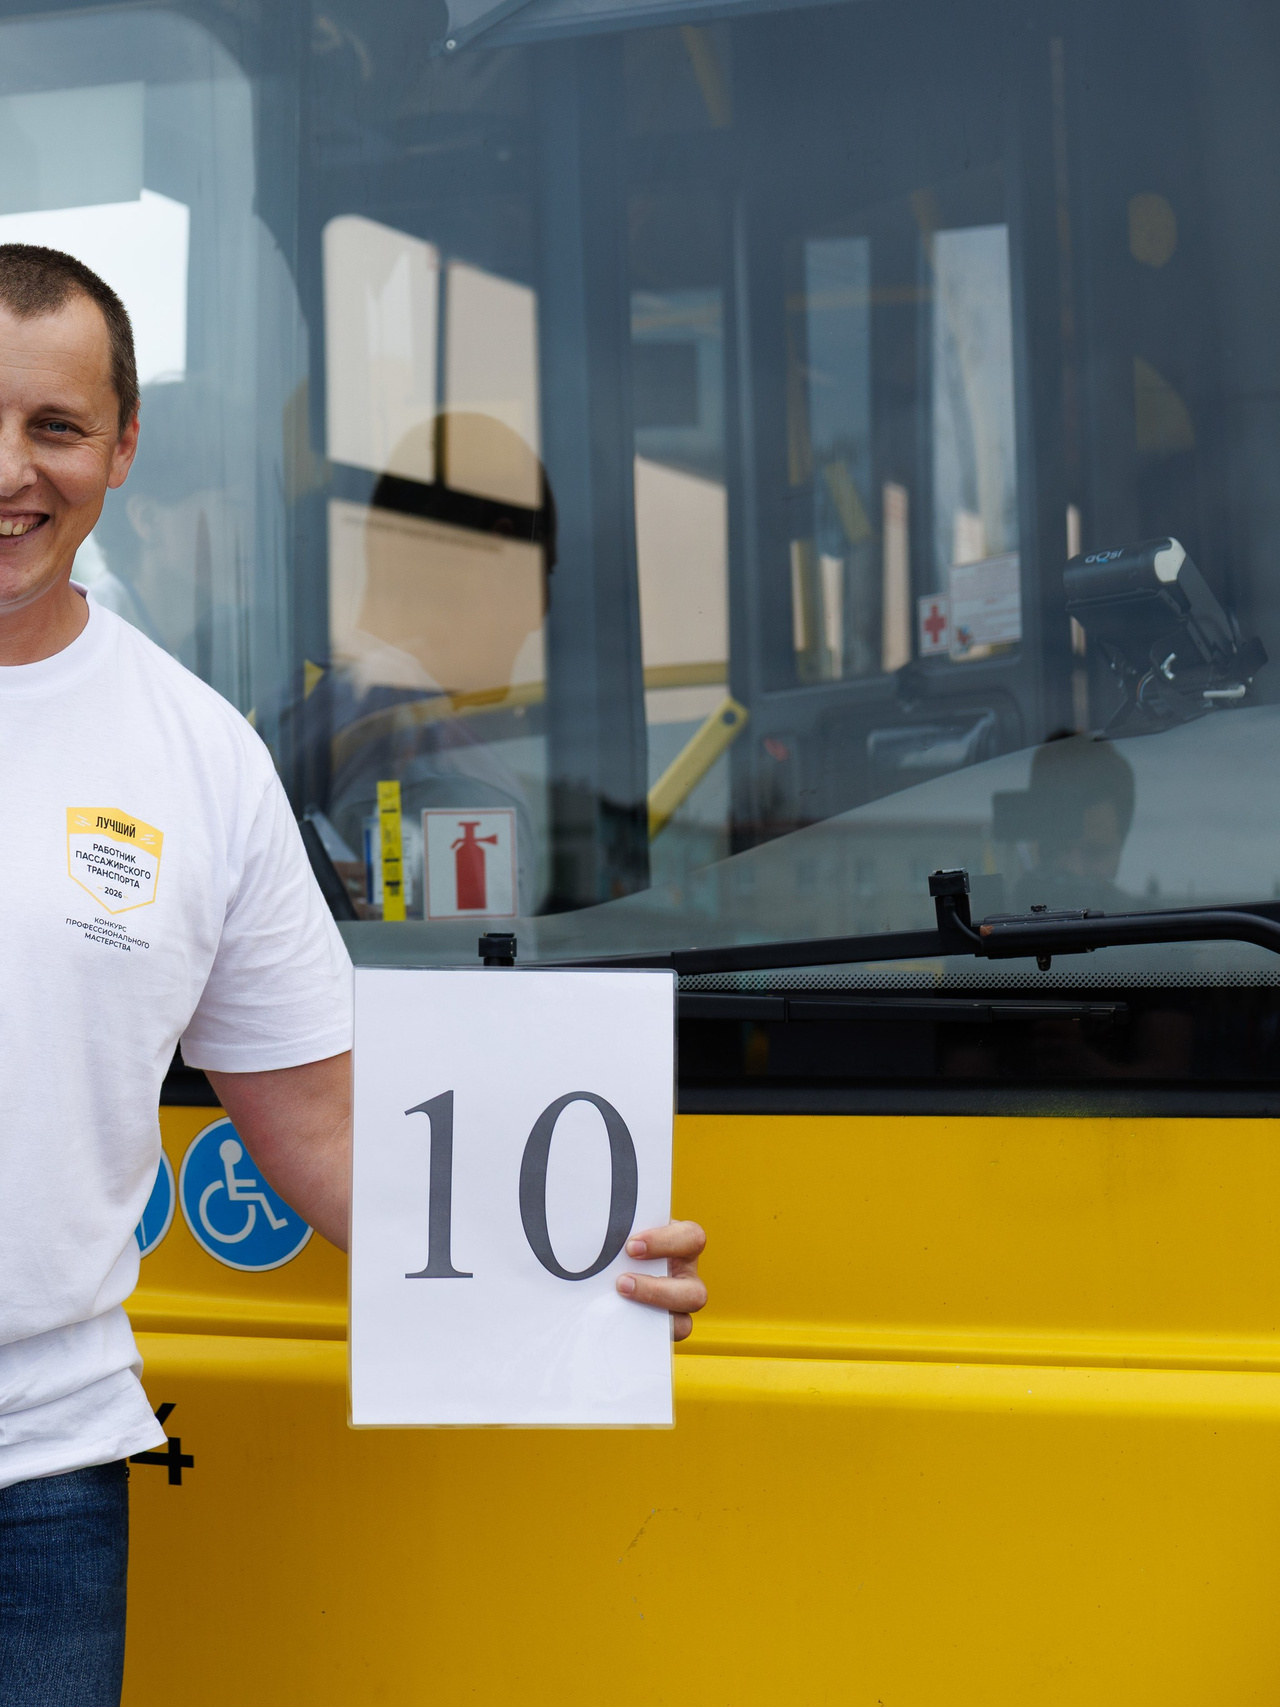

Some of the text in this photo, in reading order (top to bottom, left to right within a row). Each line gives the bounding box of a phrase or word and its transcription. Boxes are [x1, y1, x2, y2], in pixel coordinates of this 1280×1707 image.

[96, 816, 136, 838] ЛУЧШИЙ
[93, 843, 136, 863] РАБОТНИК
[75, 850, 151, 880] ПАССАЖИРСКОГО
[86, 864, 140, 888] ТРАНСПОРТА
[104, 886, 123, 899] 2026
[65, 918, 150, 949] ПРОФЕССИОНАЛЬНОГО
[94, 917, 127, 933] КОНКУРС
[84, 932, 131, 952] МАСТЕРСТВА
[404, 1089, 639, 1281] 10
